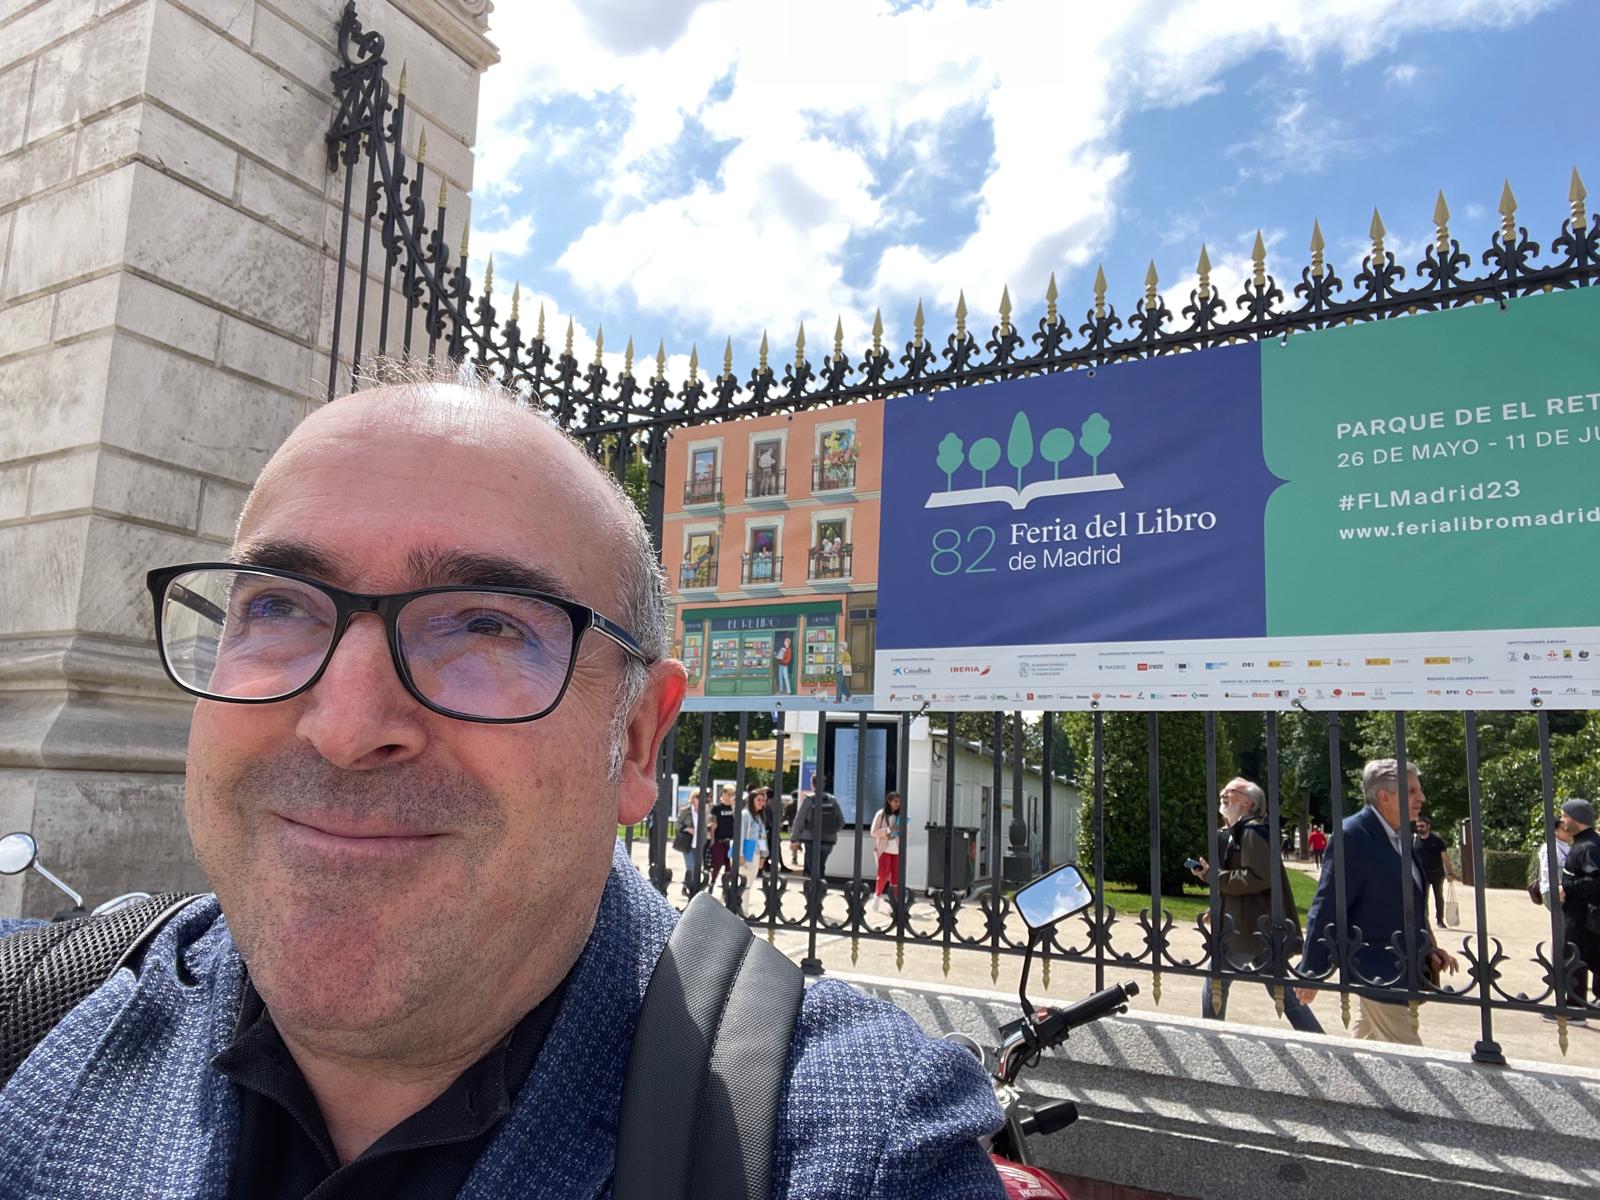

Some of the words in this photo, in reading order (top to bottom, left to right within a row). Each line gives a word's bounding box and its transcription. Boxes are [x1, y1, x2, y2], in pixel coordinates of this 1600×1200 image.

[1337, 411, 1444, 439] PARQUE
[1456, 406, 1491, 426] DE
[1502, 402, 1536, 421] EL
[1547, 393, 1600, 416] RET
[1337, 452, 1364, 468] 26
[1373, 447, 1403, 465] DE
[1412, 439, 1479, 461] MAYO
[1506, 433, 1526, 450] 11
[1536, 429, 1569, 447] DE
[1338, 480, 1521, 511] #FLMadrid23
[1339, 507, 1600, 540] www.ferialibromadrid
[930, 526, 997, 576] 82
[1009, 518, 1078, 546] Feria
[1085, 512, 1127, 539] del
[1136, 508, 1217, 536] Libro
[1008, 551, 1037, 572] de
[1043, 544, 1121, 569] Madrid
